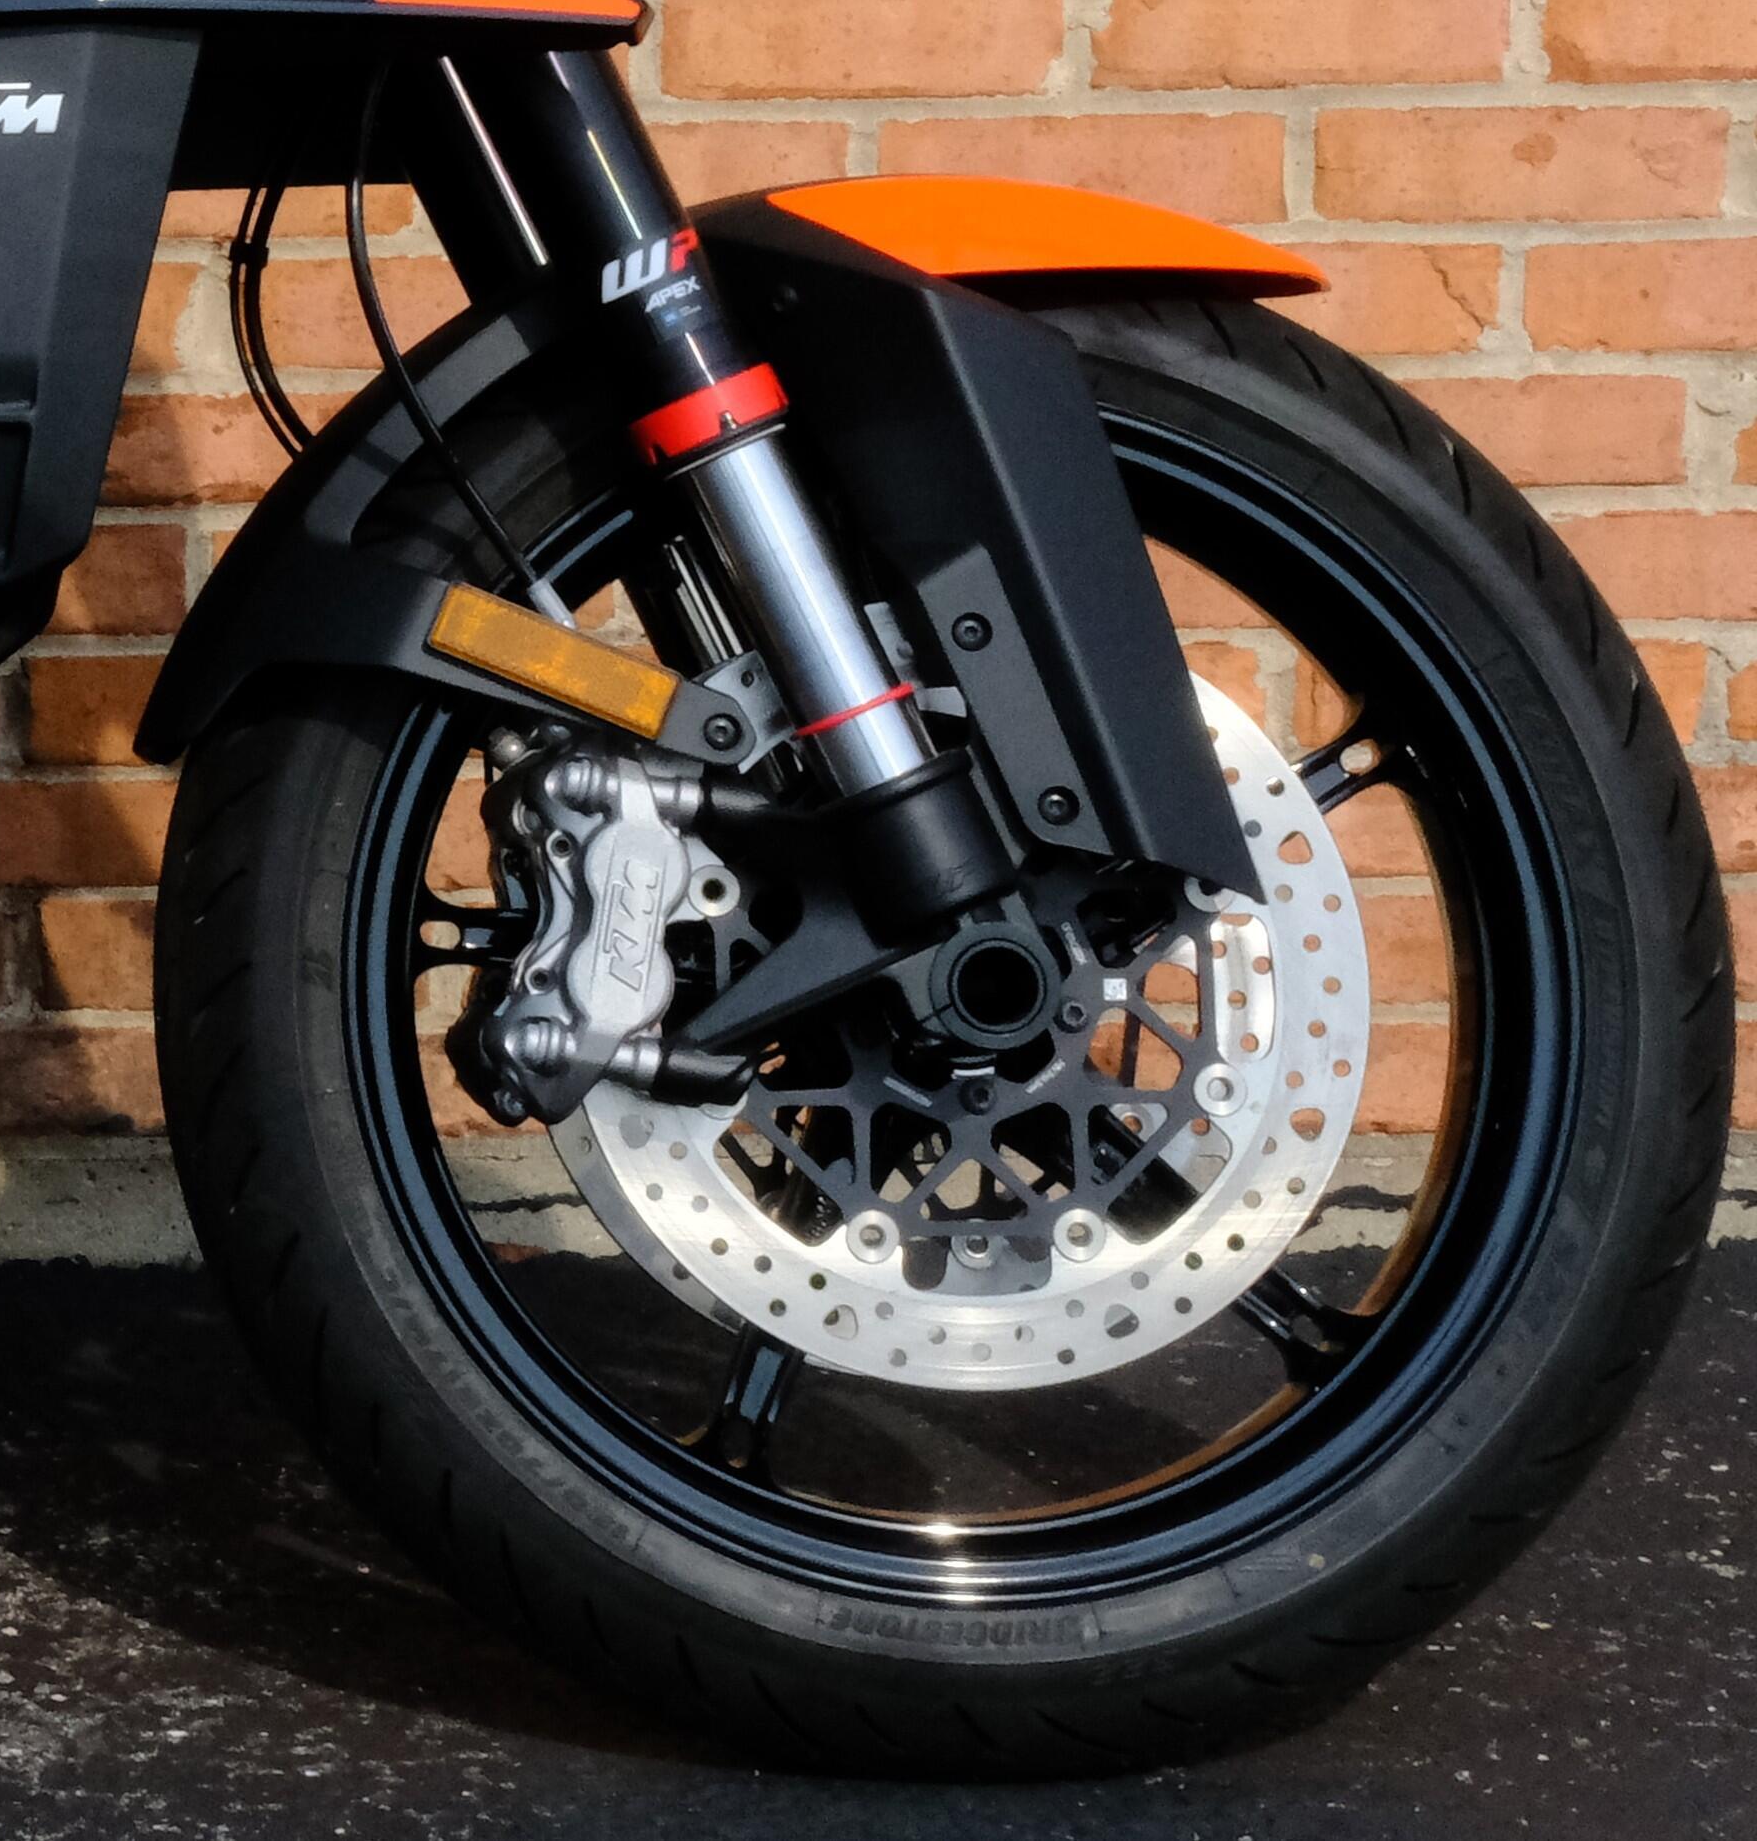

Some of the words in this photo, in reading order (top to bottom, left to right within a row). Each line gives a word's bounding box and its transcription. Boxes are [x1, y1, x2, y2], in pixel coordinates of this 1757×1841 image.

[601, 226, 701, 305] WP
[644, 274, 702, 313] APEX
[602, 858, 661, 993] KTM
